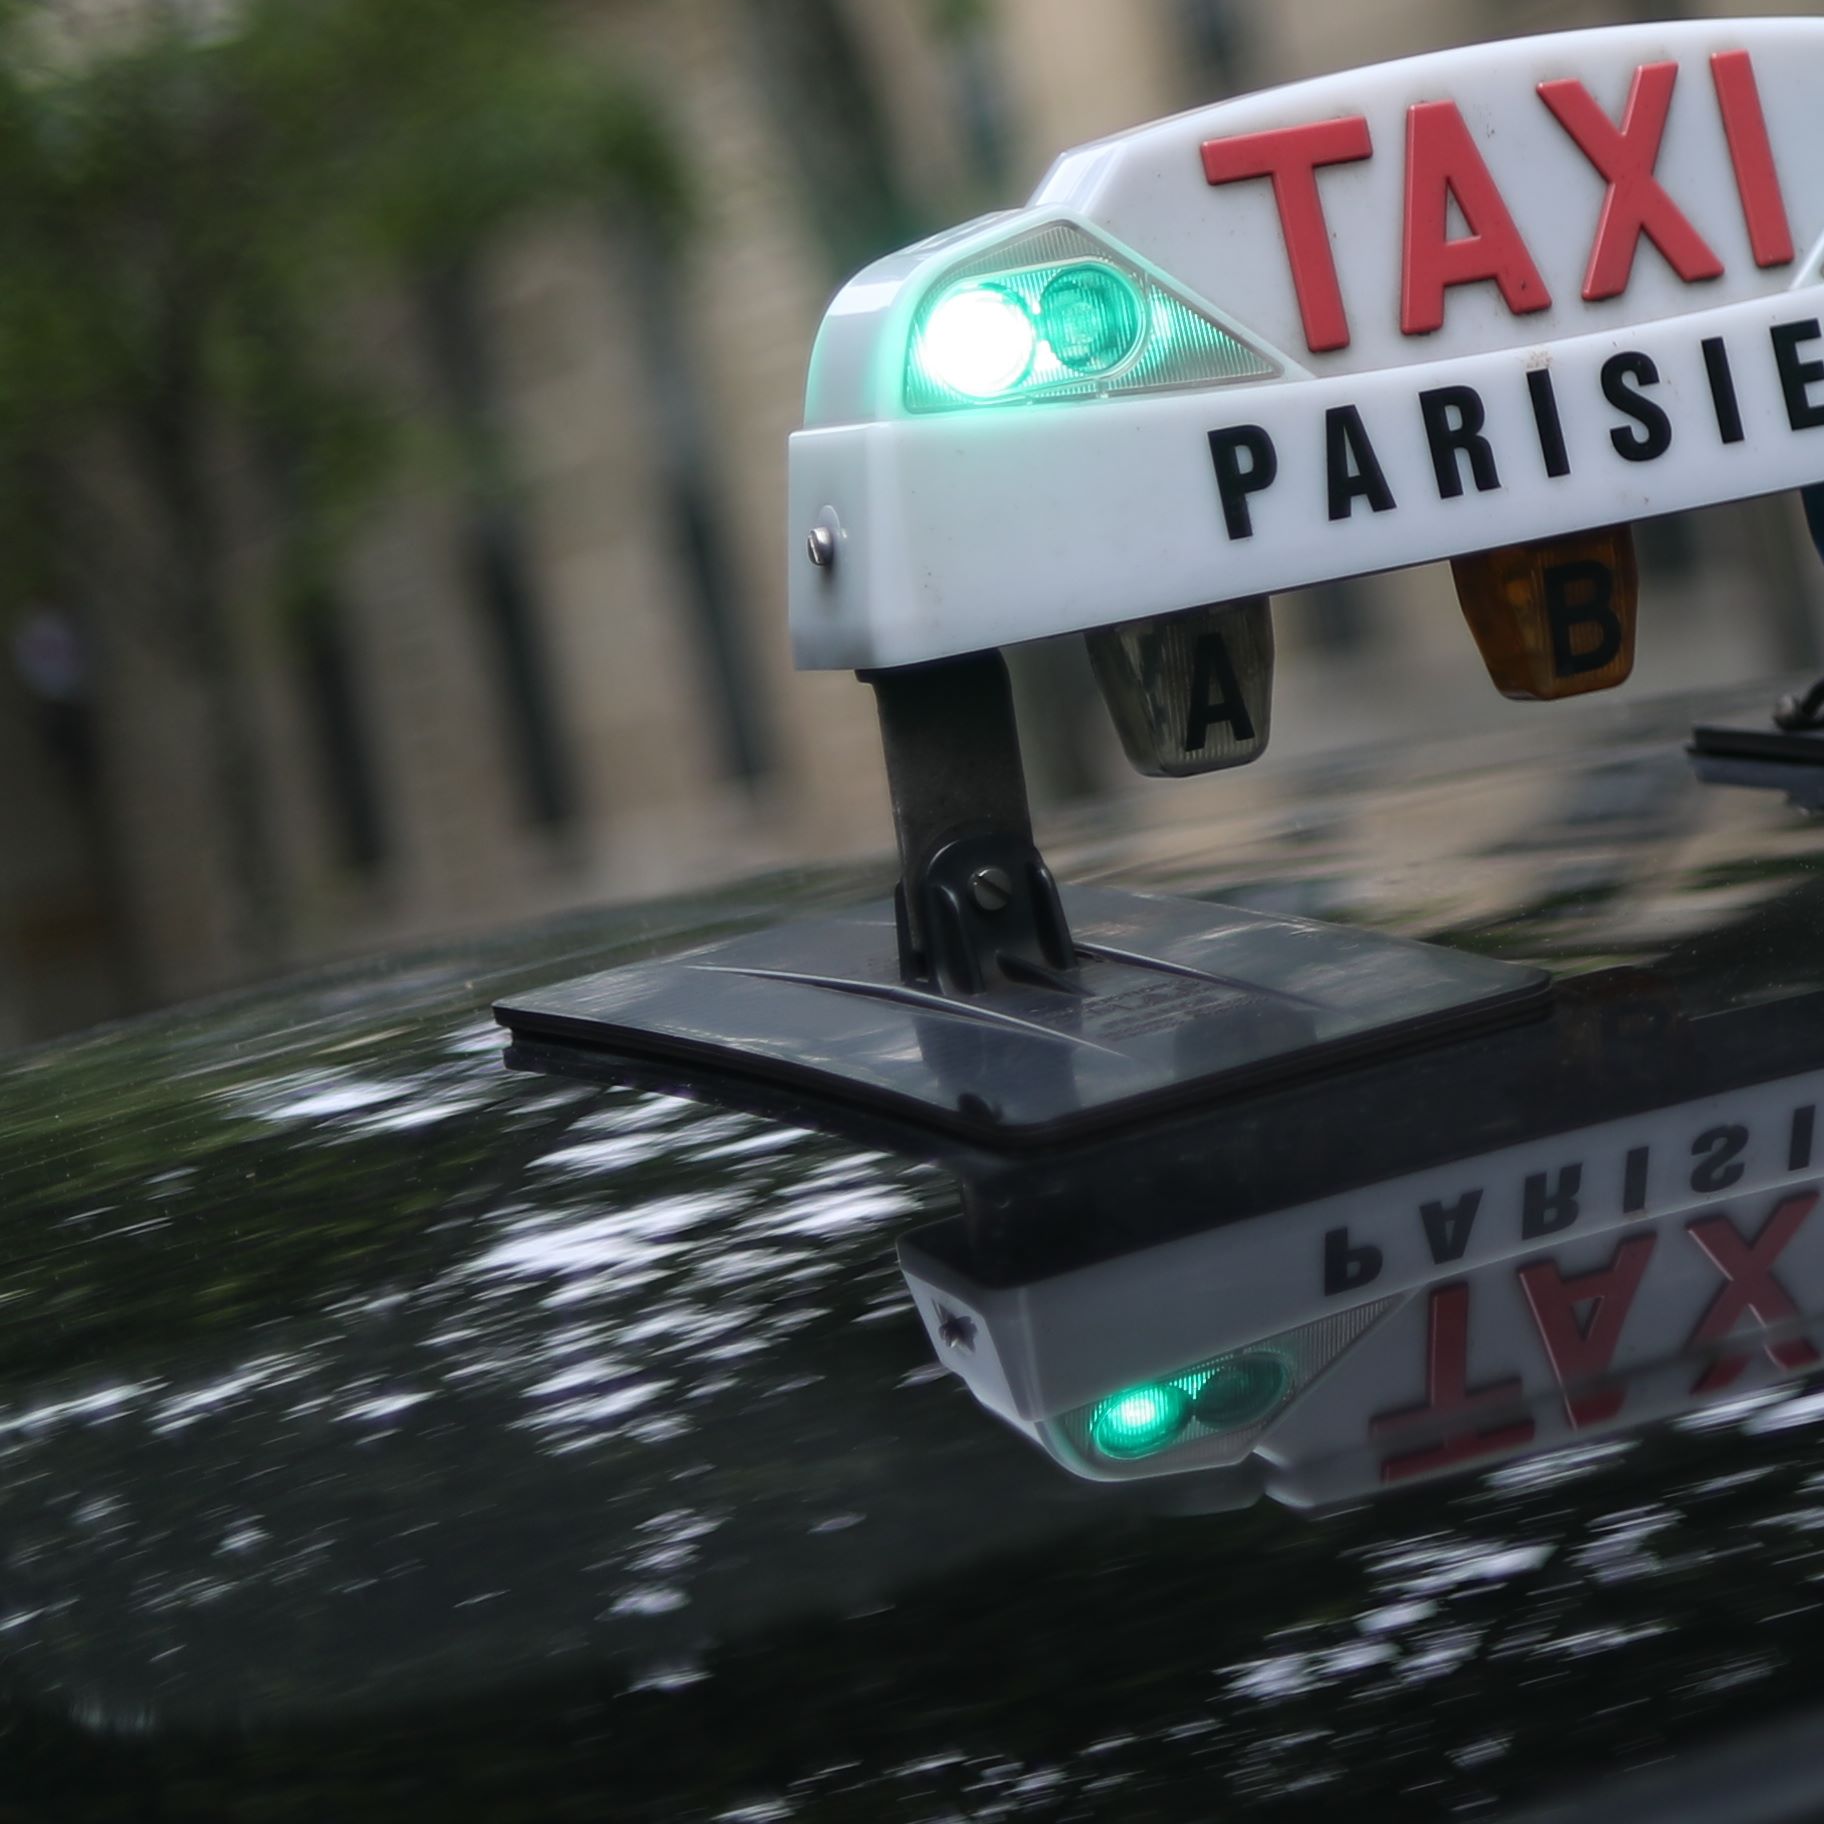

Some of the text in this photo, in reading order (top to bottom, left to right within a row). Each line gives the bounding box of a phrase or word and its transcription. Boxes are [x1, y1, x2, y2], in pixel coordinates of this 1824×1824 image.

[1201, 50, 1794, 353] TAXI
[1549, 558, 1622, 678] B
[1184, 632, 1255, 752] A
